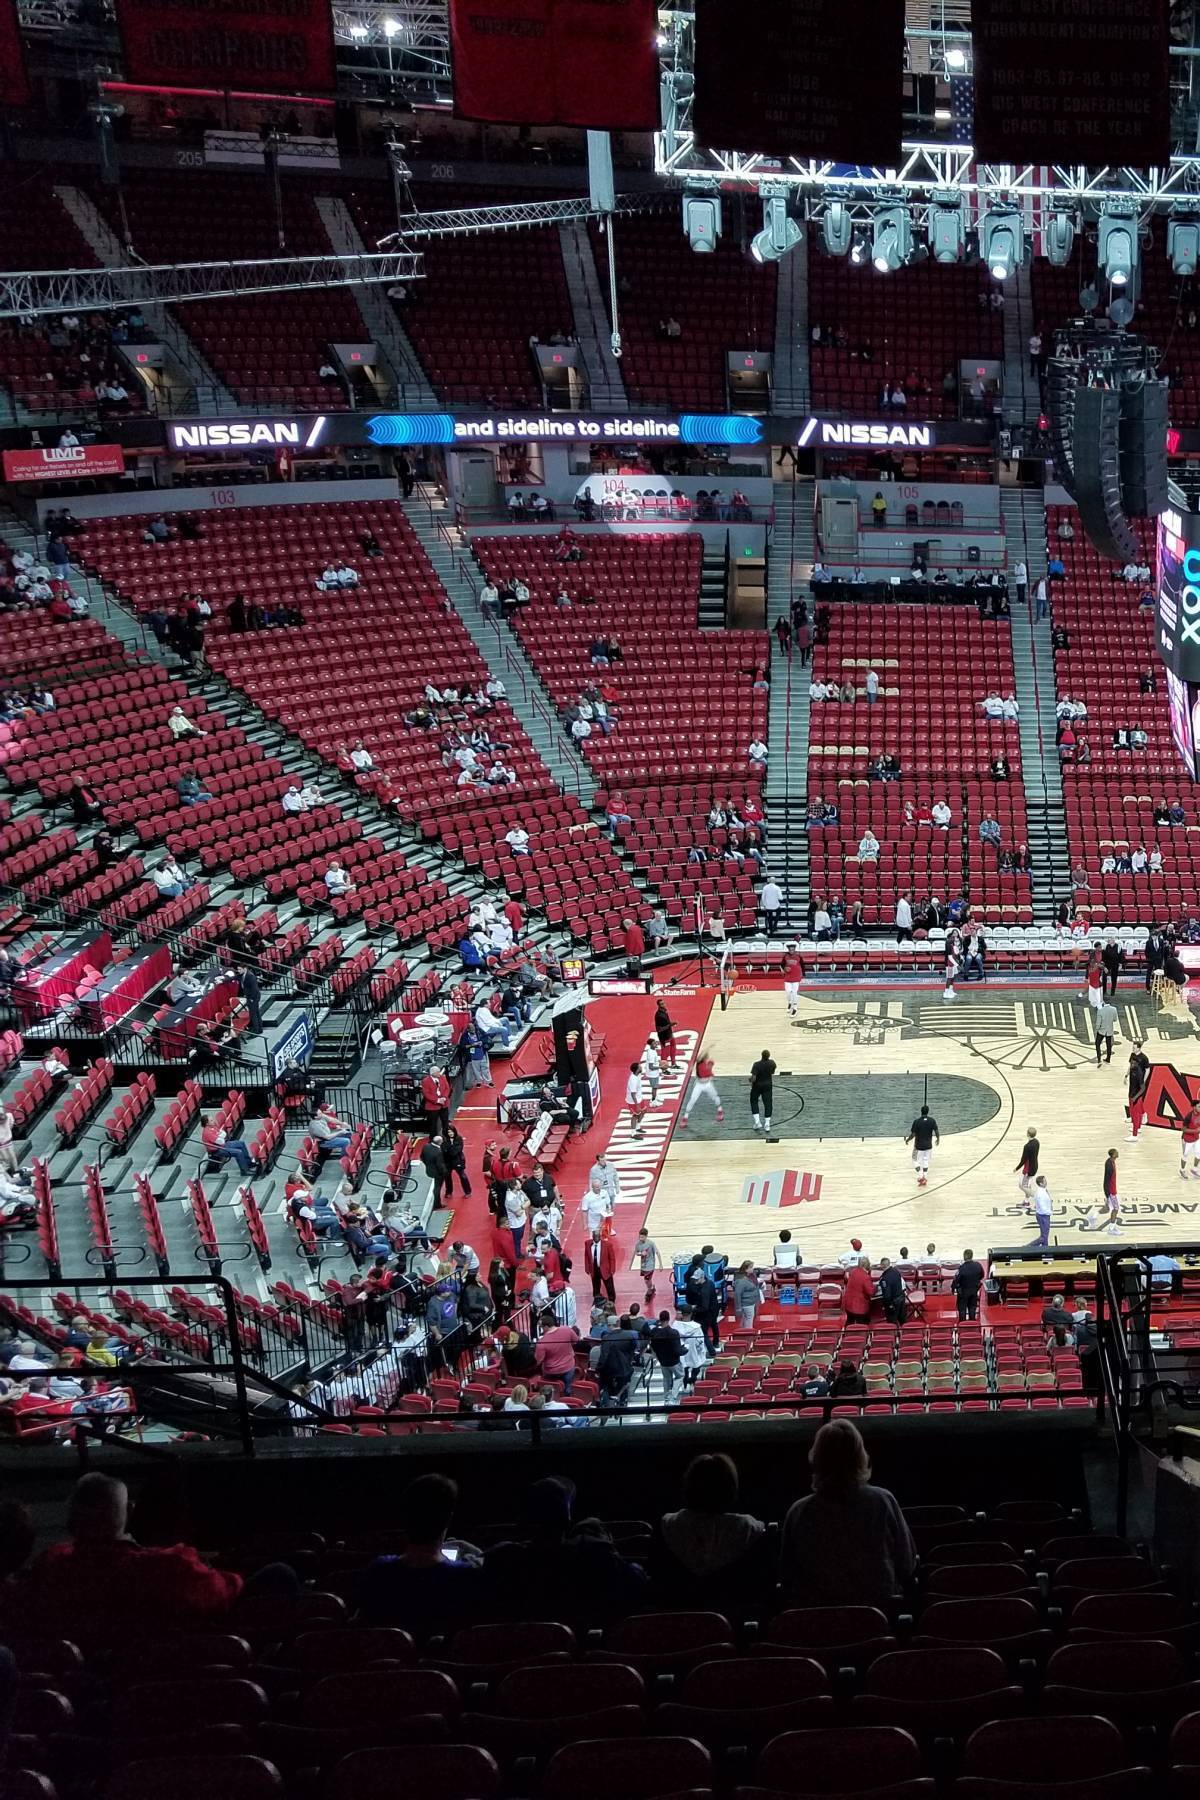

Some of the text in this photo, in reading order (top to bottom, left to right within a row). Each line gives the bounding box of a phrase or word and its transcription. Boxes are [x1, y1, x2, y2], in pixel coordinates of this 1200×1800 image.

[177, 150, 204, 167] 205
[431, 164, 455, 179] 206
[174, 422, 299, 447] NISSAN
[454, 418, 680, 436] and sideline to sideline
[823, 423, 930, 446] NISSAN
[42, 446, 86, 462] UMC
[603, 479, 625, 492] 104
[898, 486, 919, 499] 105
[210, 491, 235, 505] 103
